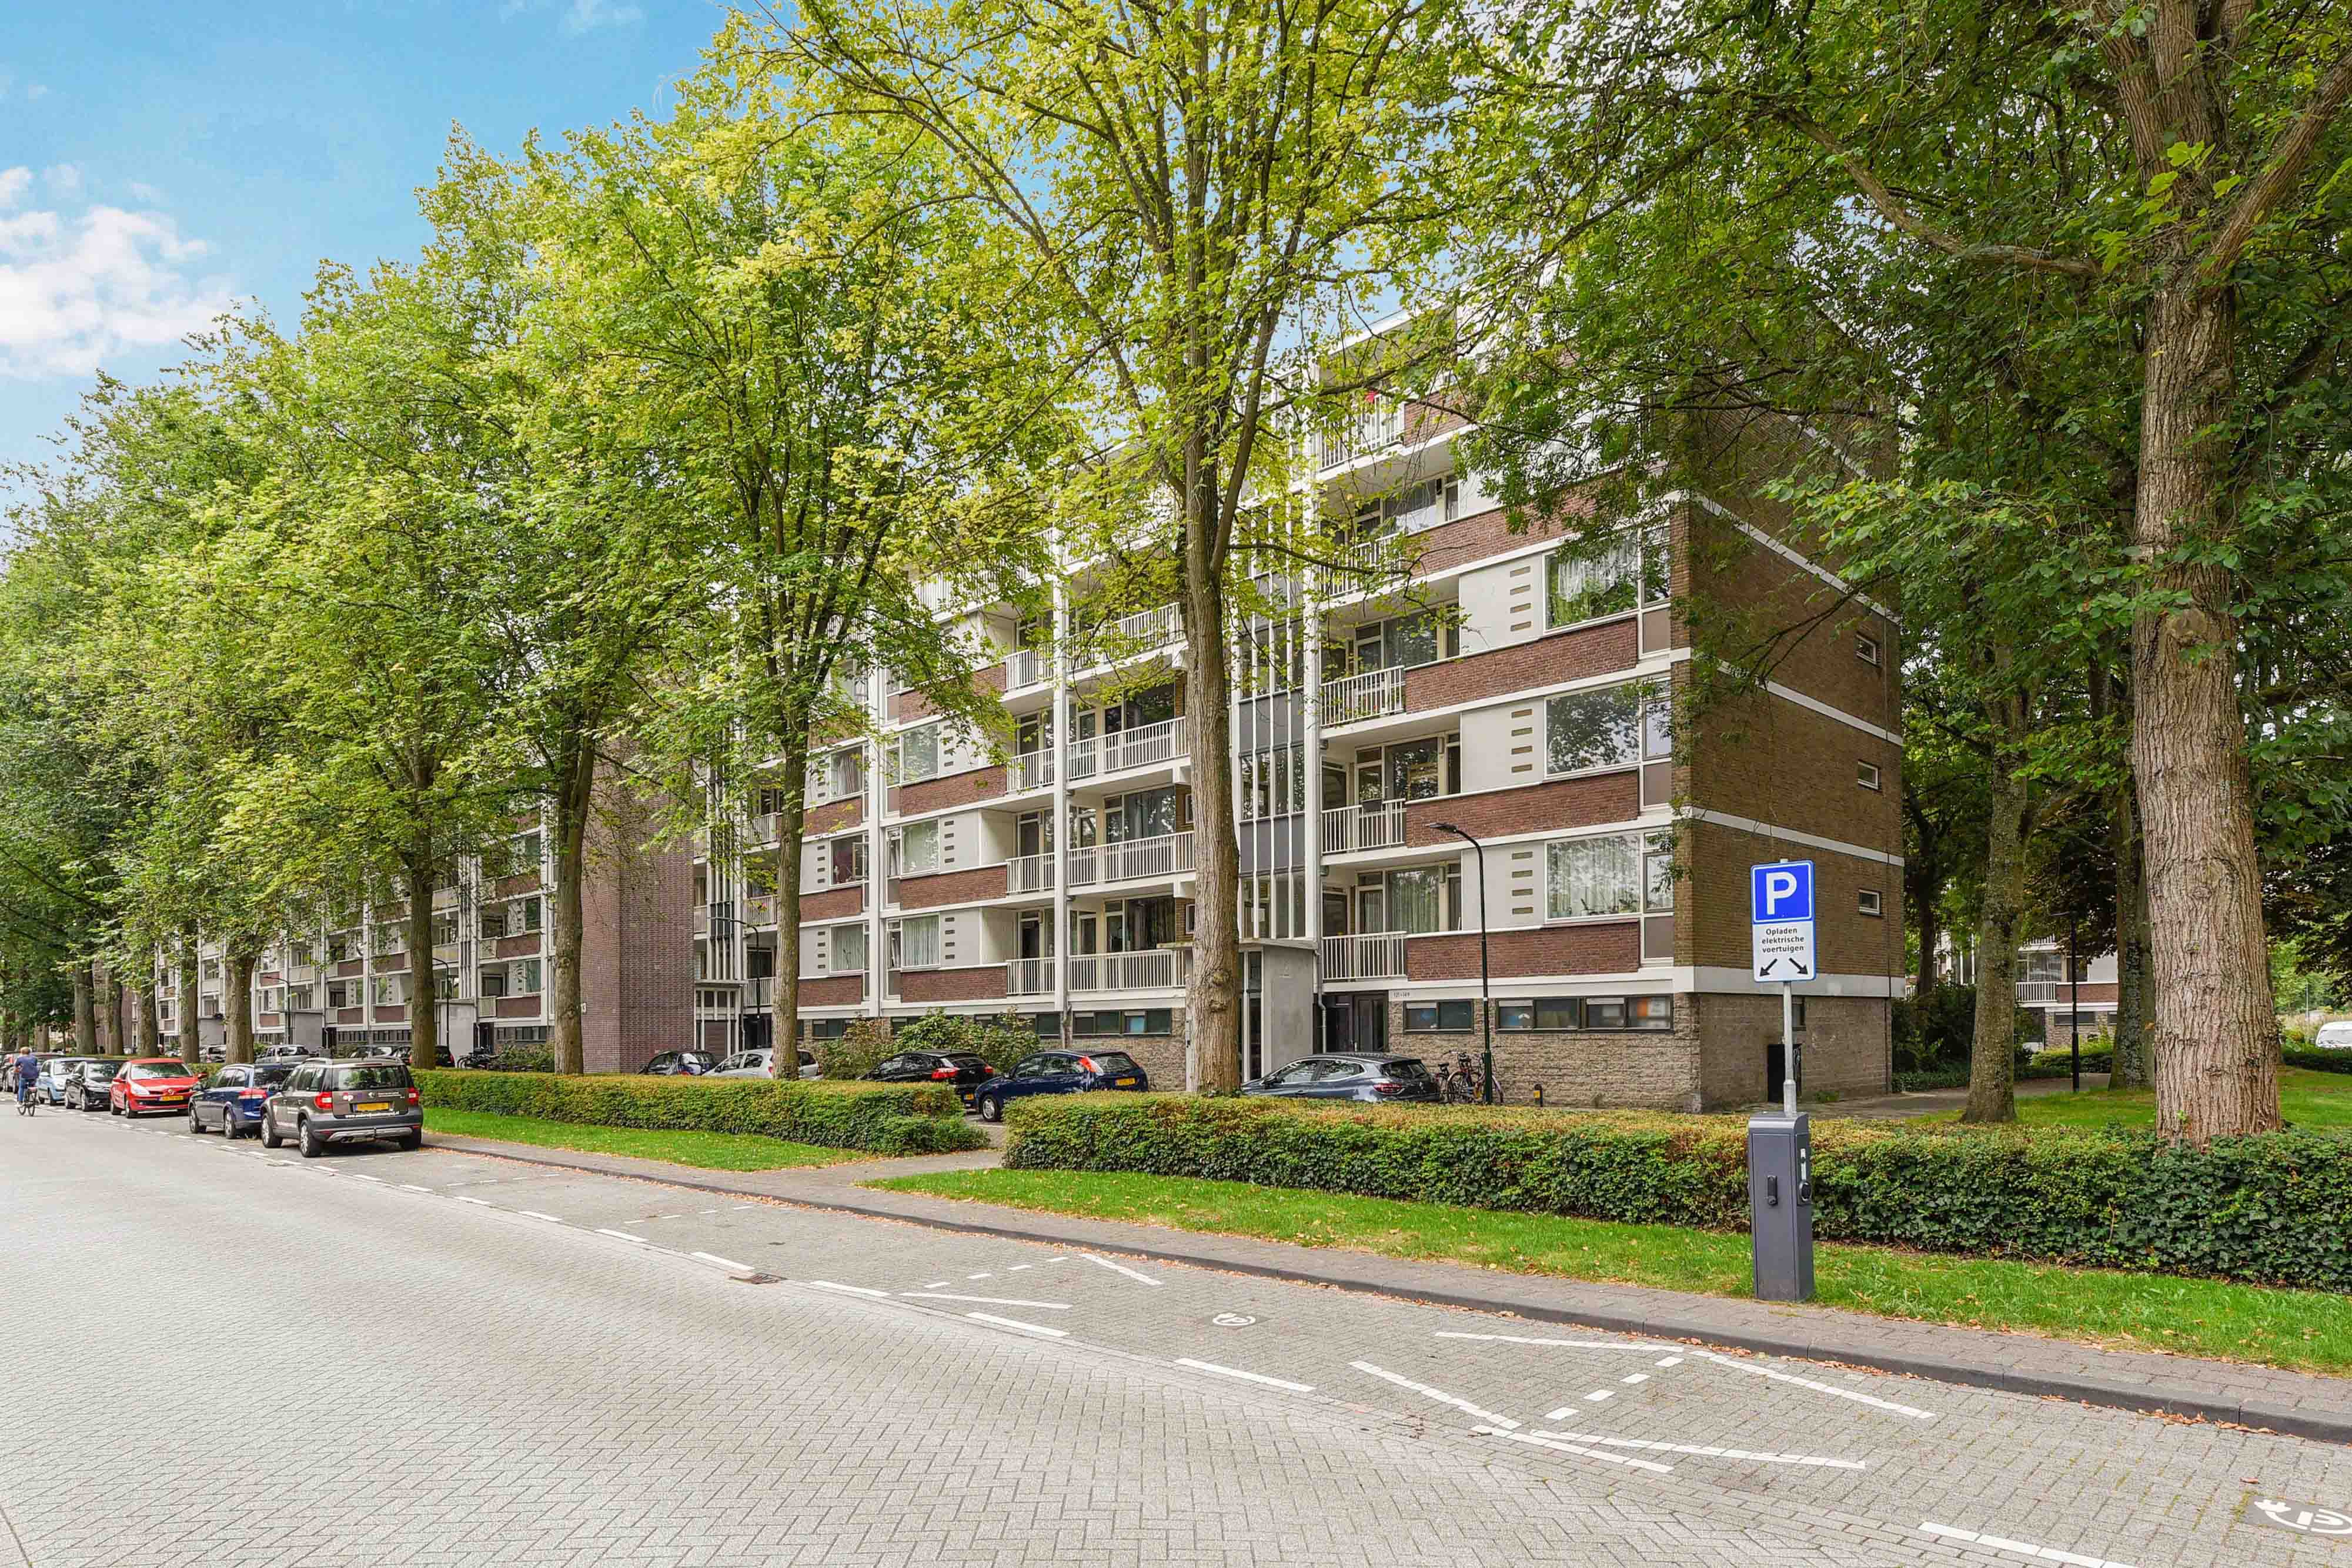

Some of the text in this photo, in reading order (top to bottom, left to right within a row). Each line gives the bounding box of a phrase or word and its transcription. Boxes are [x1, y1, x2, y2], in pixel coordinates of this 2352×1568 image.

[1766, 871, 1797, 915] P
[1766, 927, 1797, 936] Opladen
[1762, 945, 1804, 953] voertuigen
